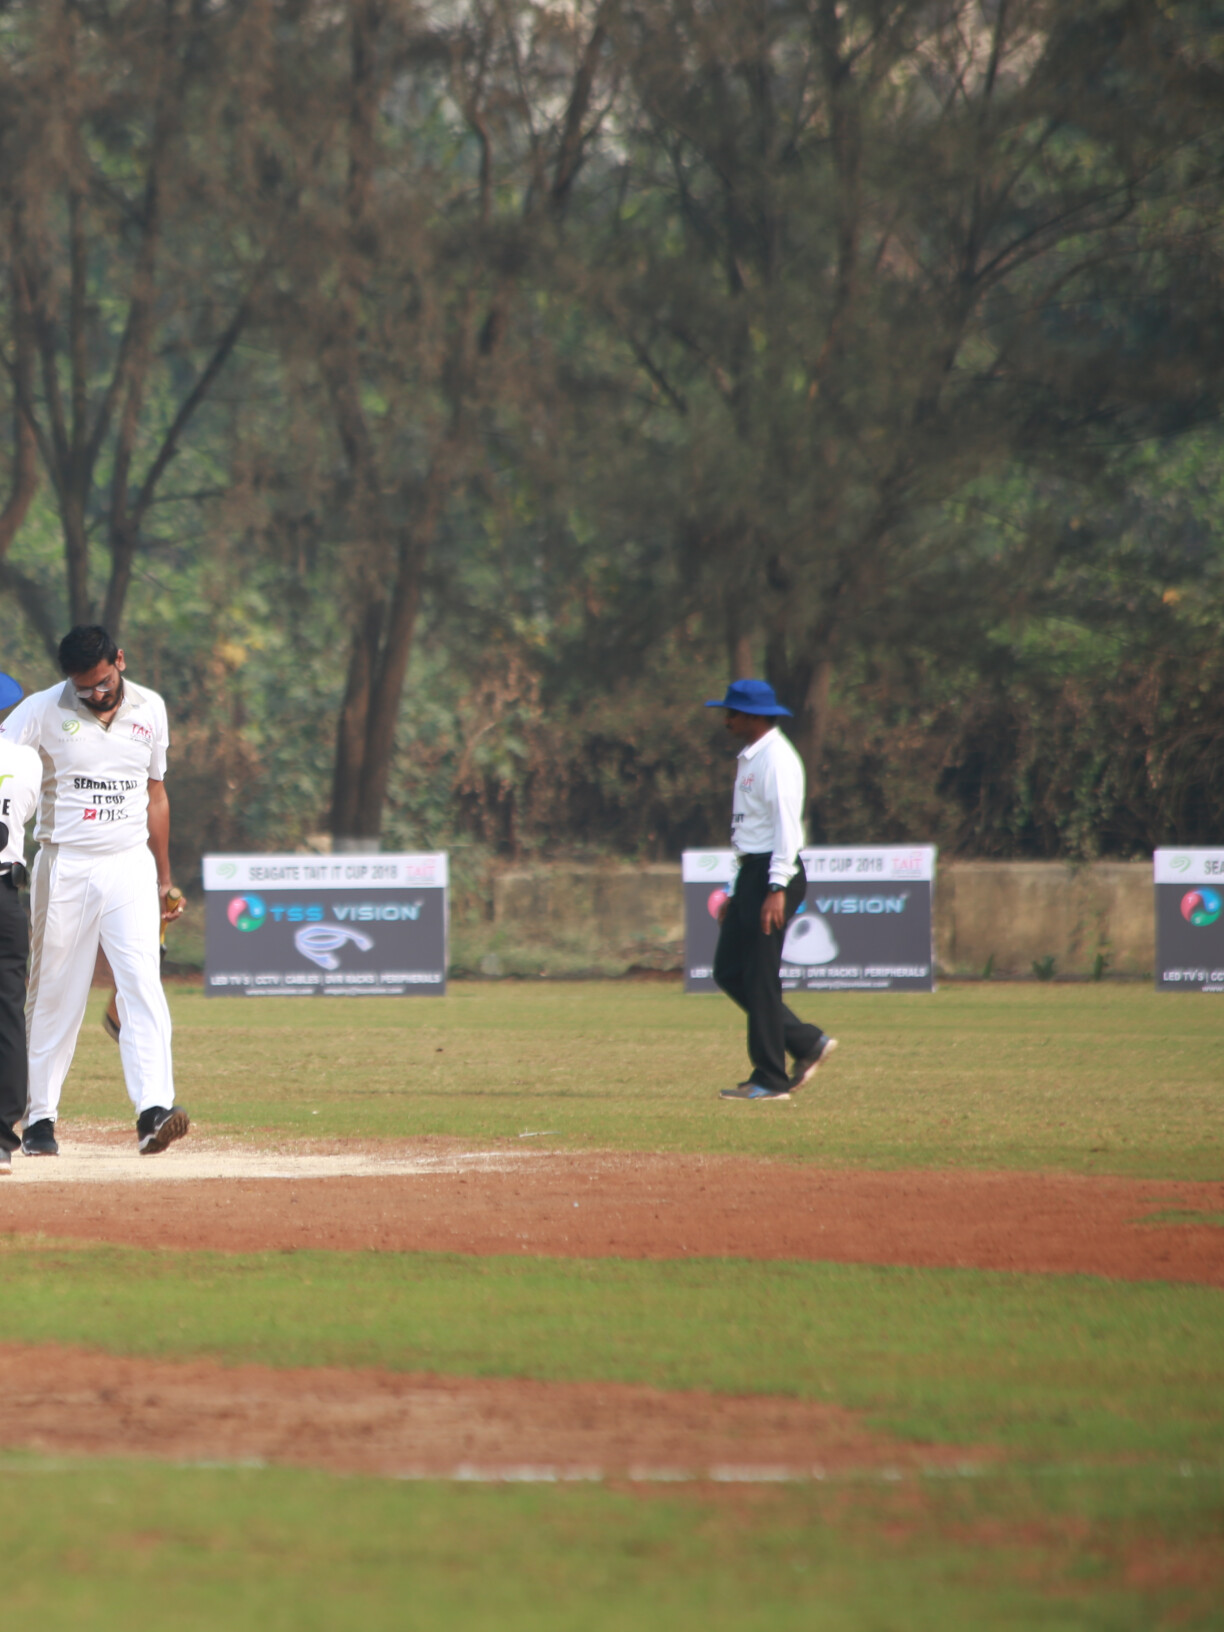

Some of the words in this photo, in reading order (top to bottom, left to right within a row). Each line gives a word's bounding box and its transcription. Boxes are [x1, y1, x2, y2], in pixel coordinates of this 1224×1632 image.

[74, 778, 117, 791] SEAGATE
[93, 795, 103, 805] IT
[105, 795, 126, 805] CUP
[99, 809, 129, 821] DBS
[814, 858, 825, 873] IT
[829, 858, 853, 873] CUP
[857, 858, 883, 872] 2018
[892, 857, 923, 871] TAIT
[249, 865, 299, 880] SEAGATE
[303, 865, 326, 880] TAIT
[331, 865, 342, 880] IT
[346, 865, 368, 880] CUP
[372, 864, 398, 879] 2018
[815, 897, 904, 914] VISION
[270, 906, 323, 922] TSS
[332, 904, 419, 921] VISION
[1163, 971, 1180, 981] LED
